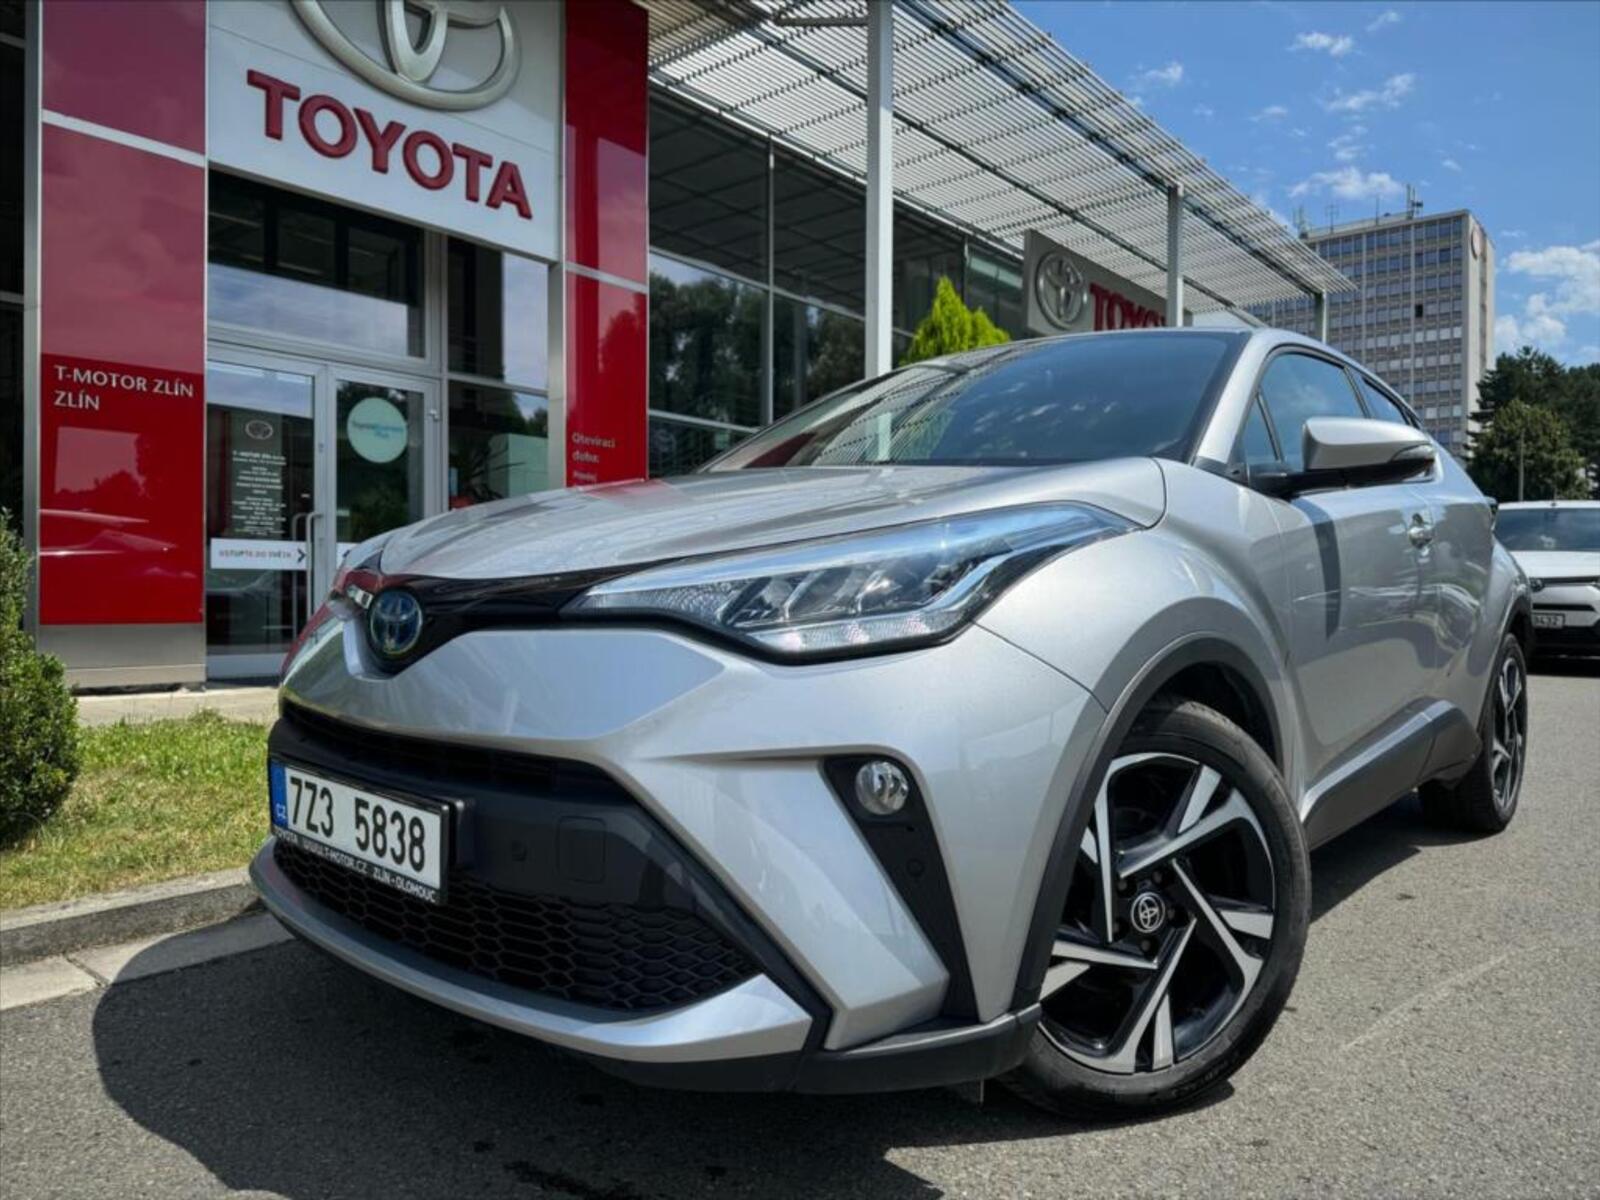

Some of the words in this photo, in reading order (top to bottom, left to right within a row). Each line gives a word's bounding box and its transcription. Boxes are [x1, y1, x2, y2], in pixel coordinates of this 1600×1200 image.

[247, 69, 532, 220] TOYOTA
[1089, 282, 1167, 331] TOYO
[53, 389, 100, 410] ZLÍN
[54, 365, 147, 391] T-MOTOR
[152, 378, 194, 397] ZLÍN
[290, 777, 334, 838] 7Z3
[354, 797, 425, 872] 5838
